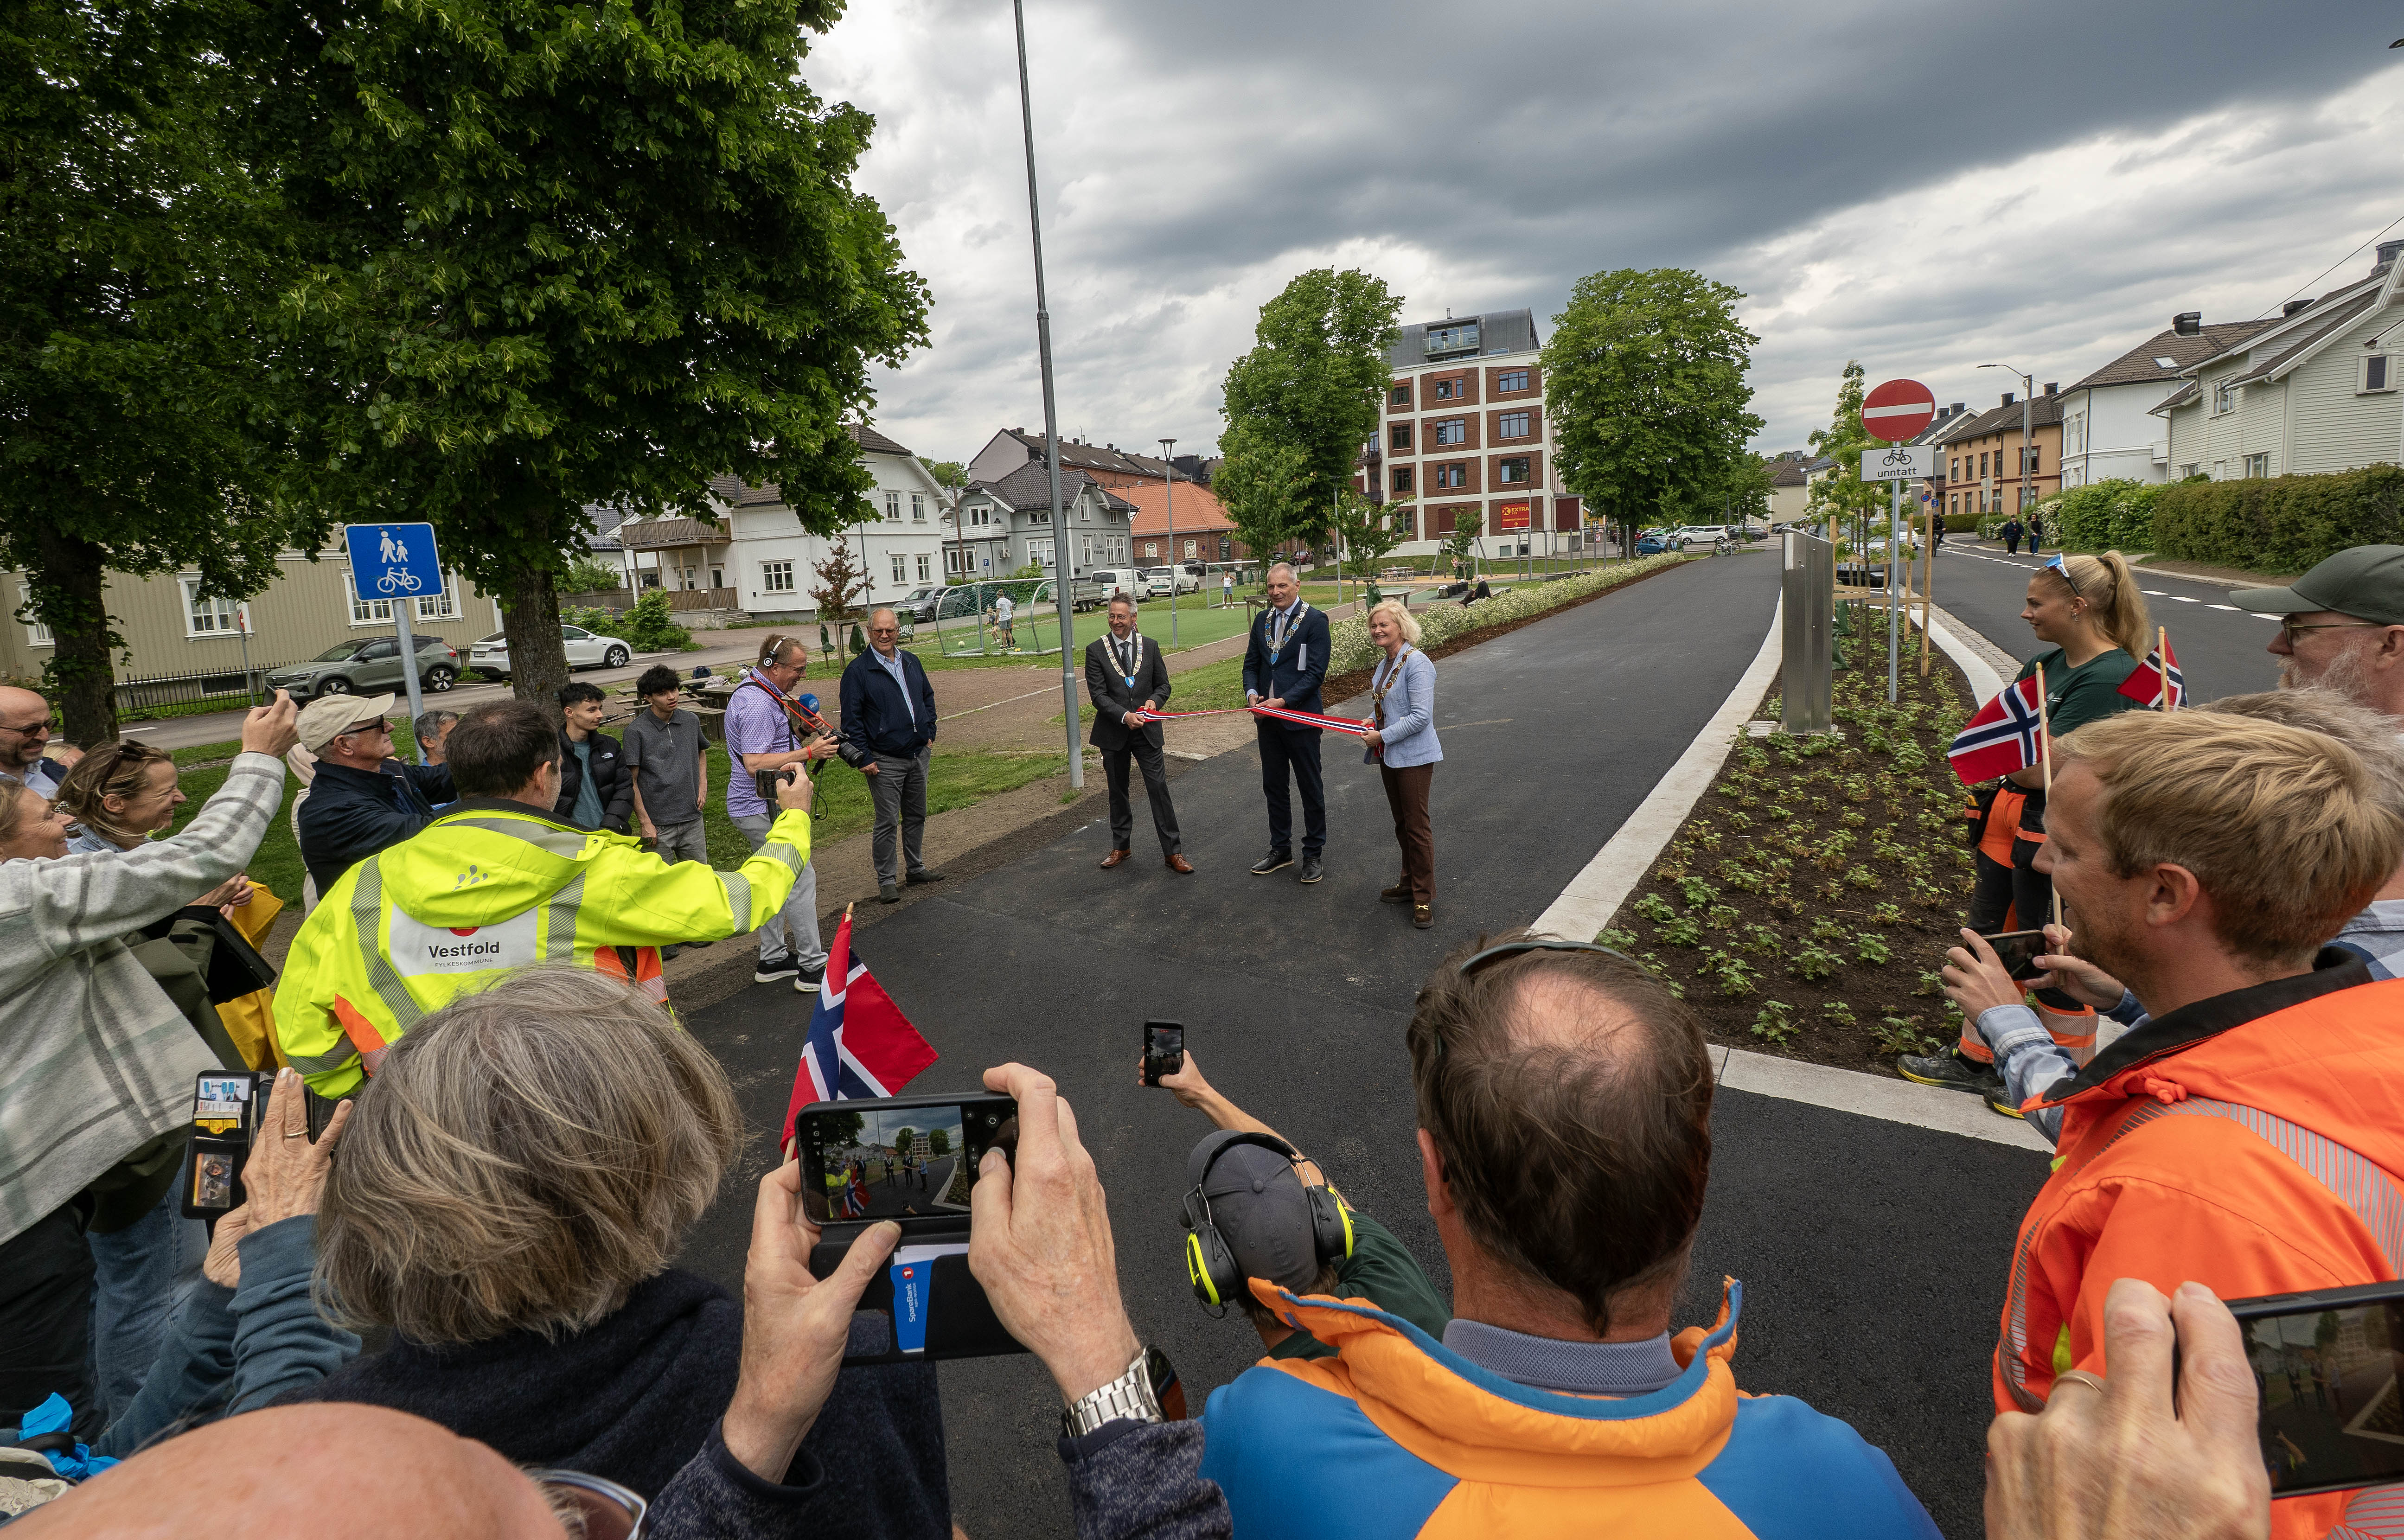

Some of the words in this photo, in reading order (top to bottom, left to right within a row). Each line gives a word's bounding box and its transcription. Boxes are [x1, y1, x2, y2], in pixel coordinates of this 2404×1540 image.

[1878, 467, 1917, 477] unntatt
[428, 941, 499, 958] Vestfold
[435, 958, 493, 967] FYLKESKOMMUNE
[905, 1283, 916, 1323] SpareBank
